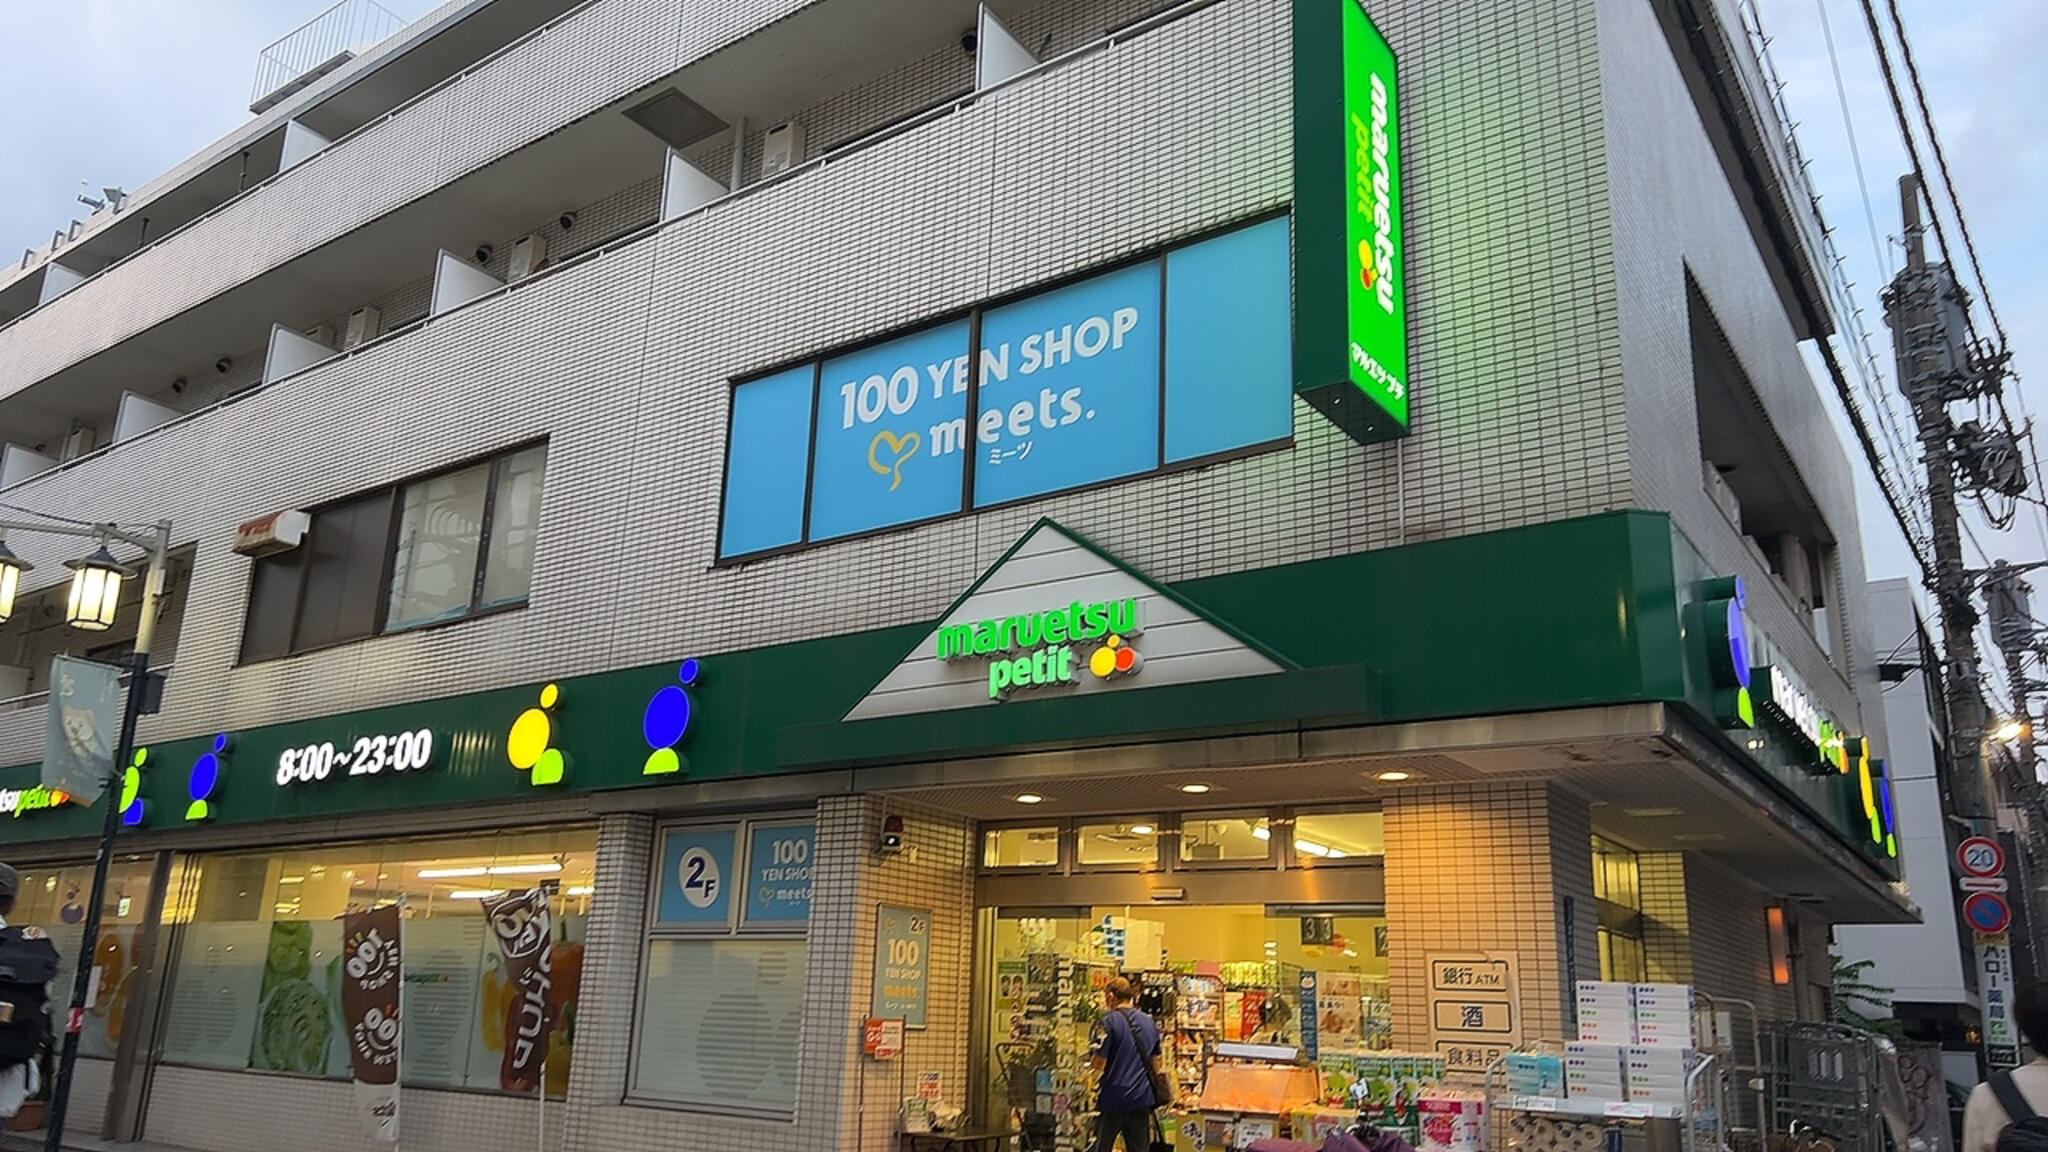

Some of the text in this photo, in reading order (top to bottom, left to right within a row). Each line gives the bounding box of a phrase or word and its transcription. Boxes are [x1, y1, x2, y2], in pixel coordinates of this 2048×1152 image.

[1351, 112, 1375, 223] petit
[1370, 71, 1395, 316] maruetsu
[840, 307, 1139, 429] 100 YEN SHOP
[989, 440, 1033, 465] ミーツ
[936, 598, 1137, 661] maruetsu
[988, 645, 1073, 699] petit
[772, 839, 808, 865] 100
[1967, 848, 1994, 867] 20
[685, 856, 717, 898] 2F
[761, 867, 785, 881] YEN
[888, 938, 919, 966] 100
[1442, 966, 1499, 985] 銀行 ATM
[1461, 1005, 1484, 1028] 酒
[1446, 1046, 1500, 1067] 食料品
